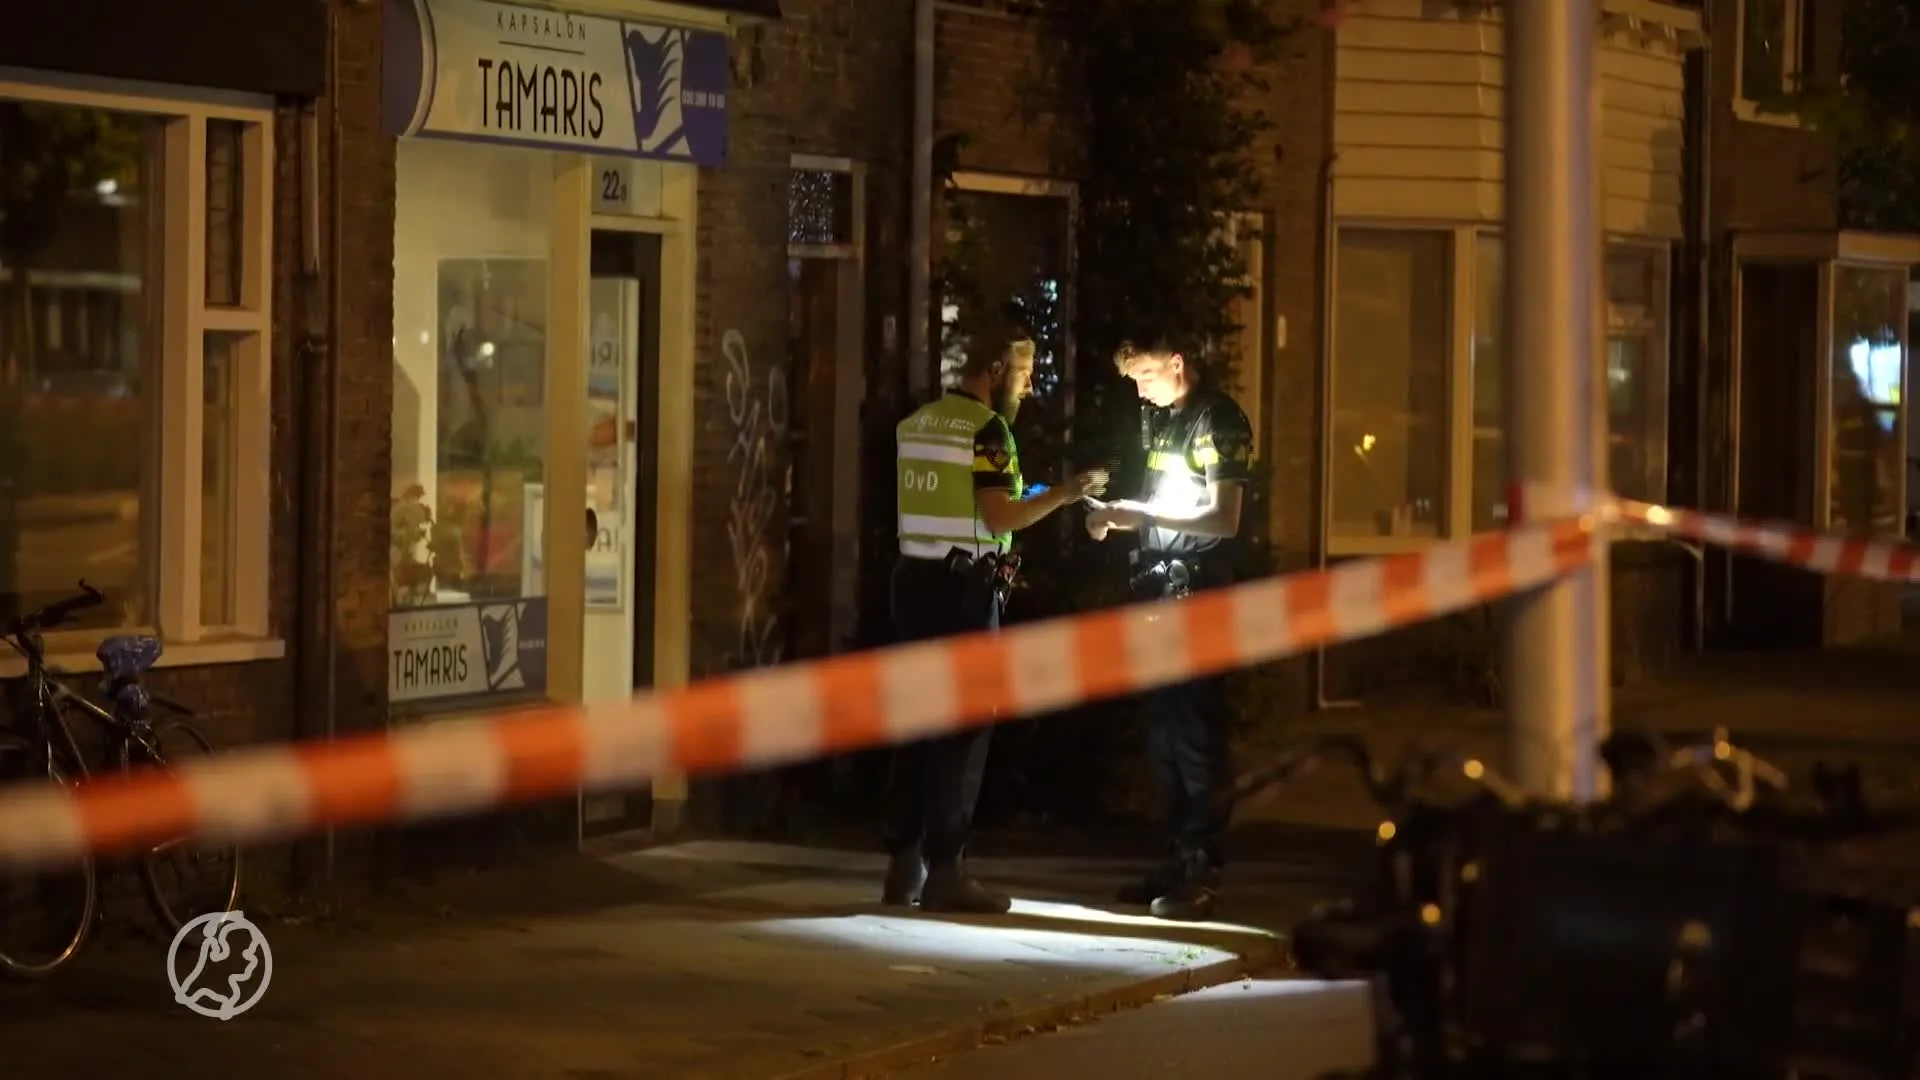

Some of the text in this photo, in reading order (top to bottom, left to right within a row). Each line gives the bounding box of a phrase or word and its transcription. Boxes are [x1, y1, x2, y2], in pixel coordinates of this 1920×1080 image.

[497, 9, 586, 40] KAPSALON
[478, 58, 603, 139] TAMARIS
[904, 469, 939, 492] OvD
[394, 644, 468, 691] TAMARIS
